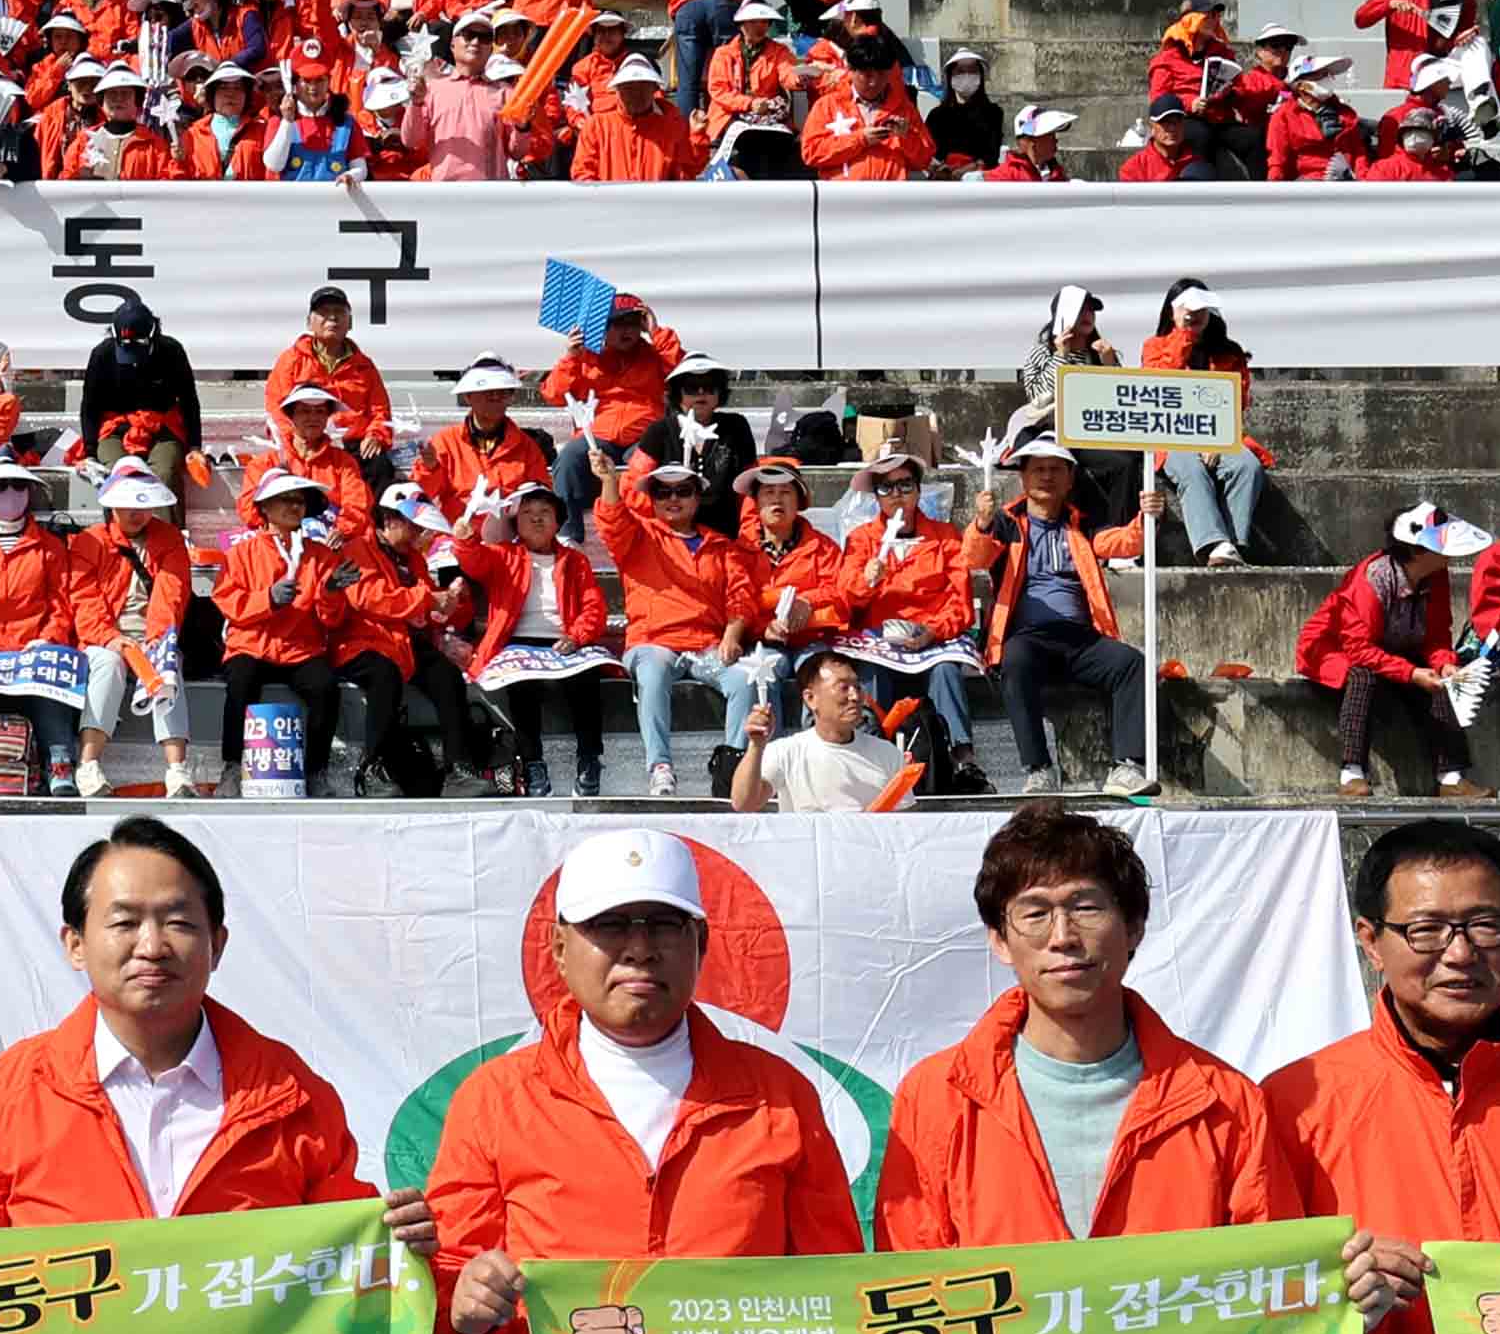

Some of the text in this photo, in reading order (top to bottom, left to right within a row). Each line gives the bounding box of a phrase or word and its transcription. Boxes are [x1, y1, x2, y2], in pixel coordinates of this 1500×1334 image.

[52, 217, 430, 325] 동구
[1115, 384, 1184, 409] 만석동
[1081, 409, 1217, 437] 행정복지센터
[132, 1264, 187, 1315] 가
[669, 1294, 833, 1324] 2023 인천시민
